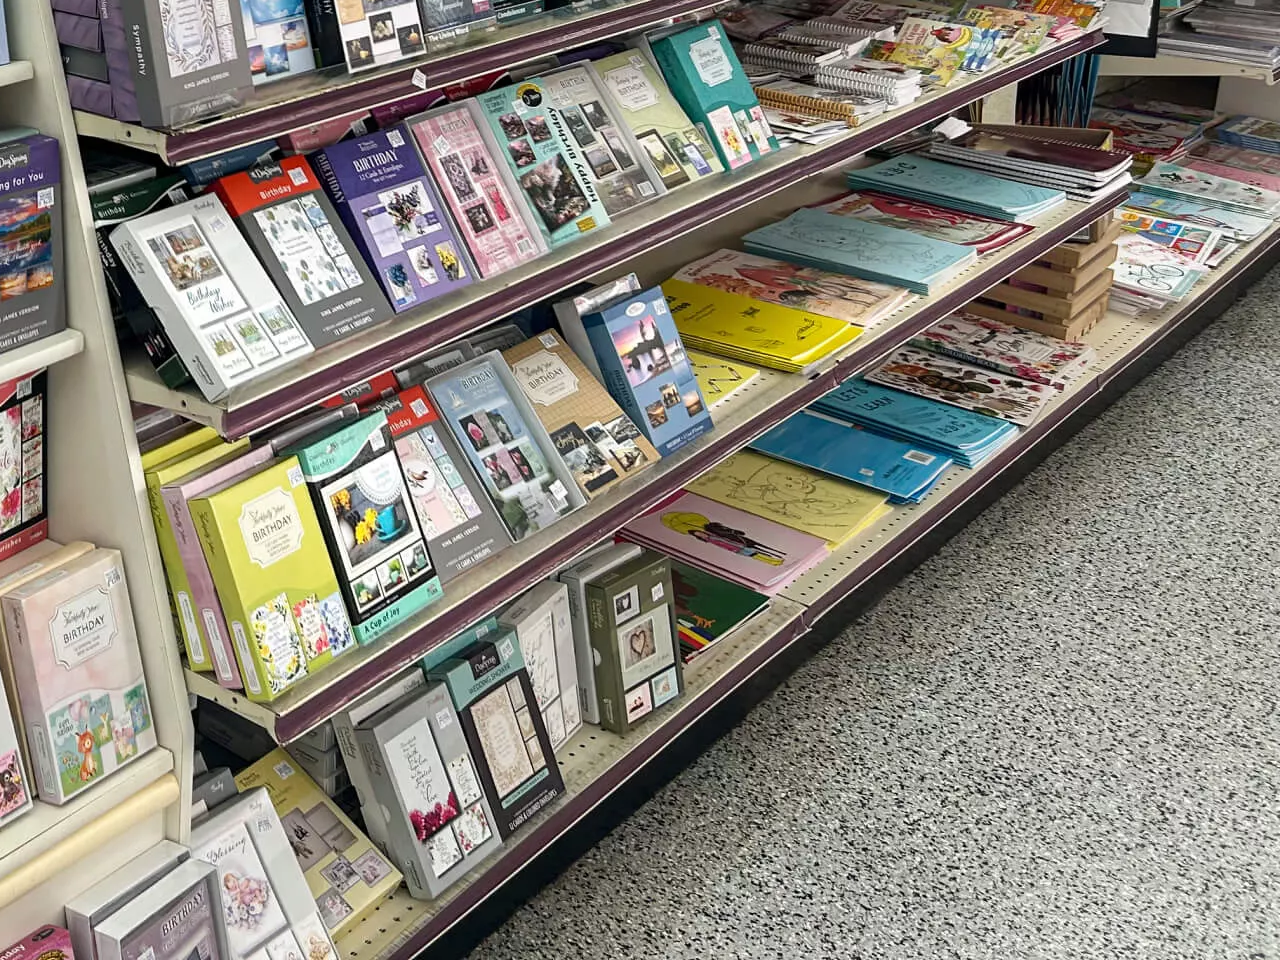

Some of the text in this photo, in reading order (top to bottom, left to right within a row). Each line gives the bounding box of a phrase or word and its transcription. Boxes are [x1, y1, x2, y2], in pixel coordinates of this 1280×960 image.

[131, 23, 147, 77] Sympathy
[352, 149, 399, 173] BIRTHDAY
[13, 175, 25, 188] for
[28, 171, 44, 183] You
[260, 184, 292, 201] Birthday
[98, 205, 126, 219] Birthday
[252, 515, 293, 541] BIRTHDAY
[62, 612, 108, 647] BIRTHDAY
[159, 886, 206, 940] BIRTHDAY
